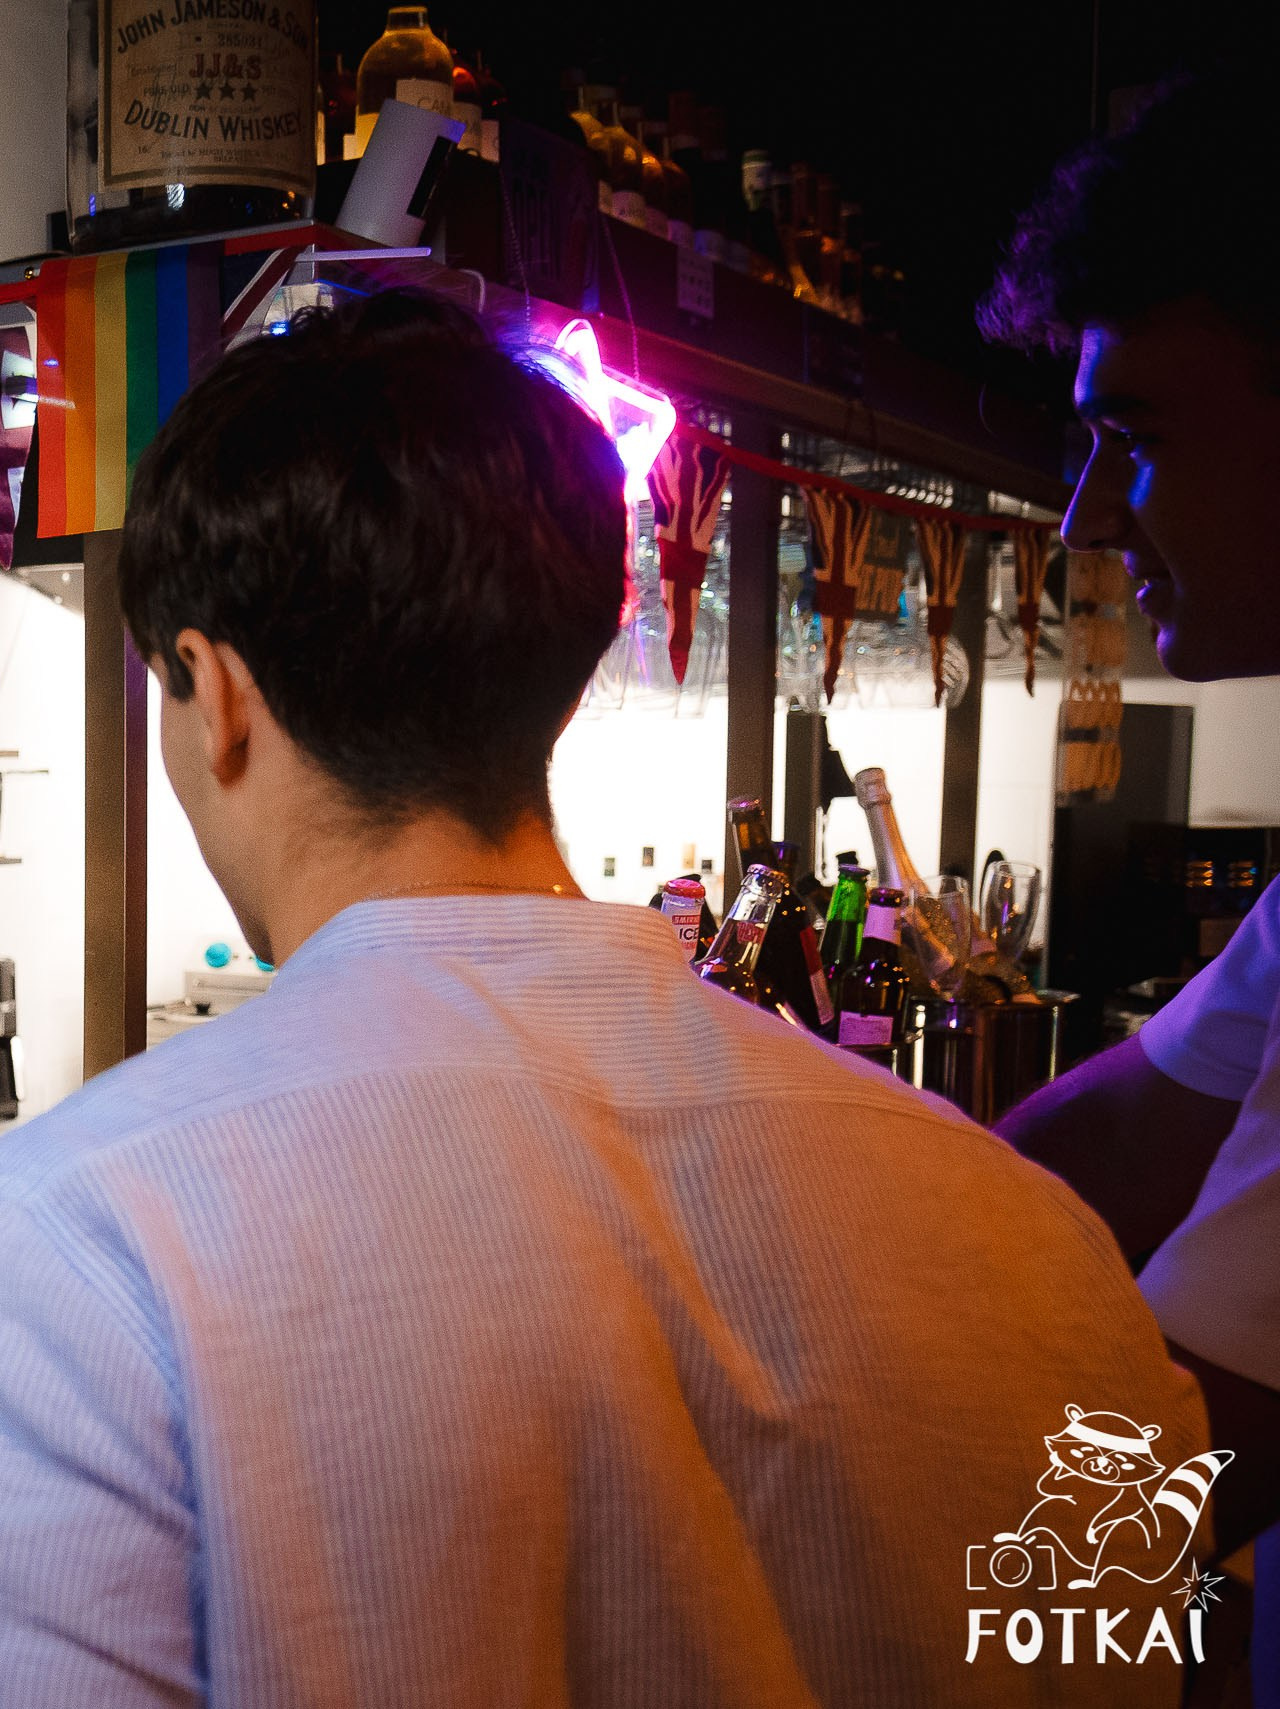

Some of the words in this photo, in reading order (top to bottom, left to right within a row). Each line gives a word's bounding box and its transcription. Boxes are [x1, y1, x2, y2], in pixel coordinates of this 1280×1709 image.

[117, 10, 166, 53] JOHN
[171, 0, 266, 26] JAMESON
[267, 10, 280, 31] &
[124, 99, 209, 141] DUBLIN
[218, 111, 302, 142] WHISKEY
